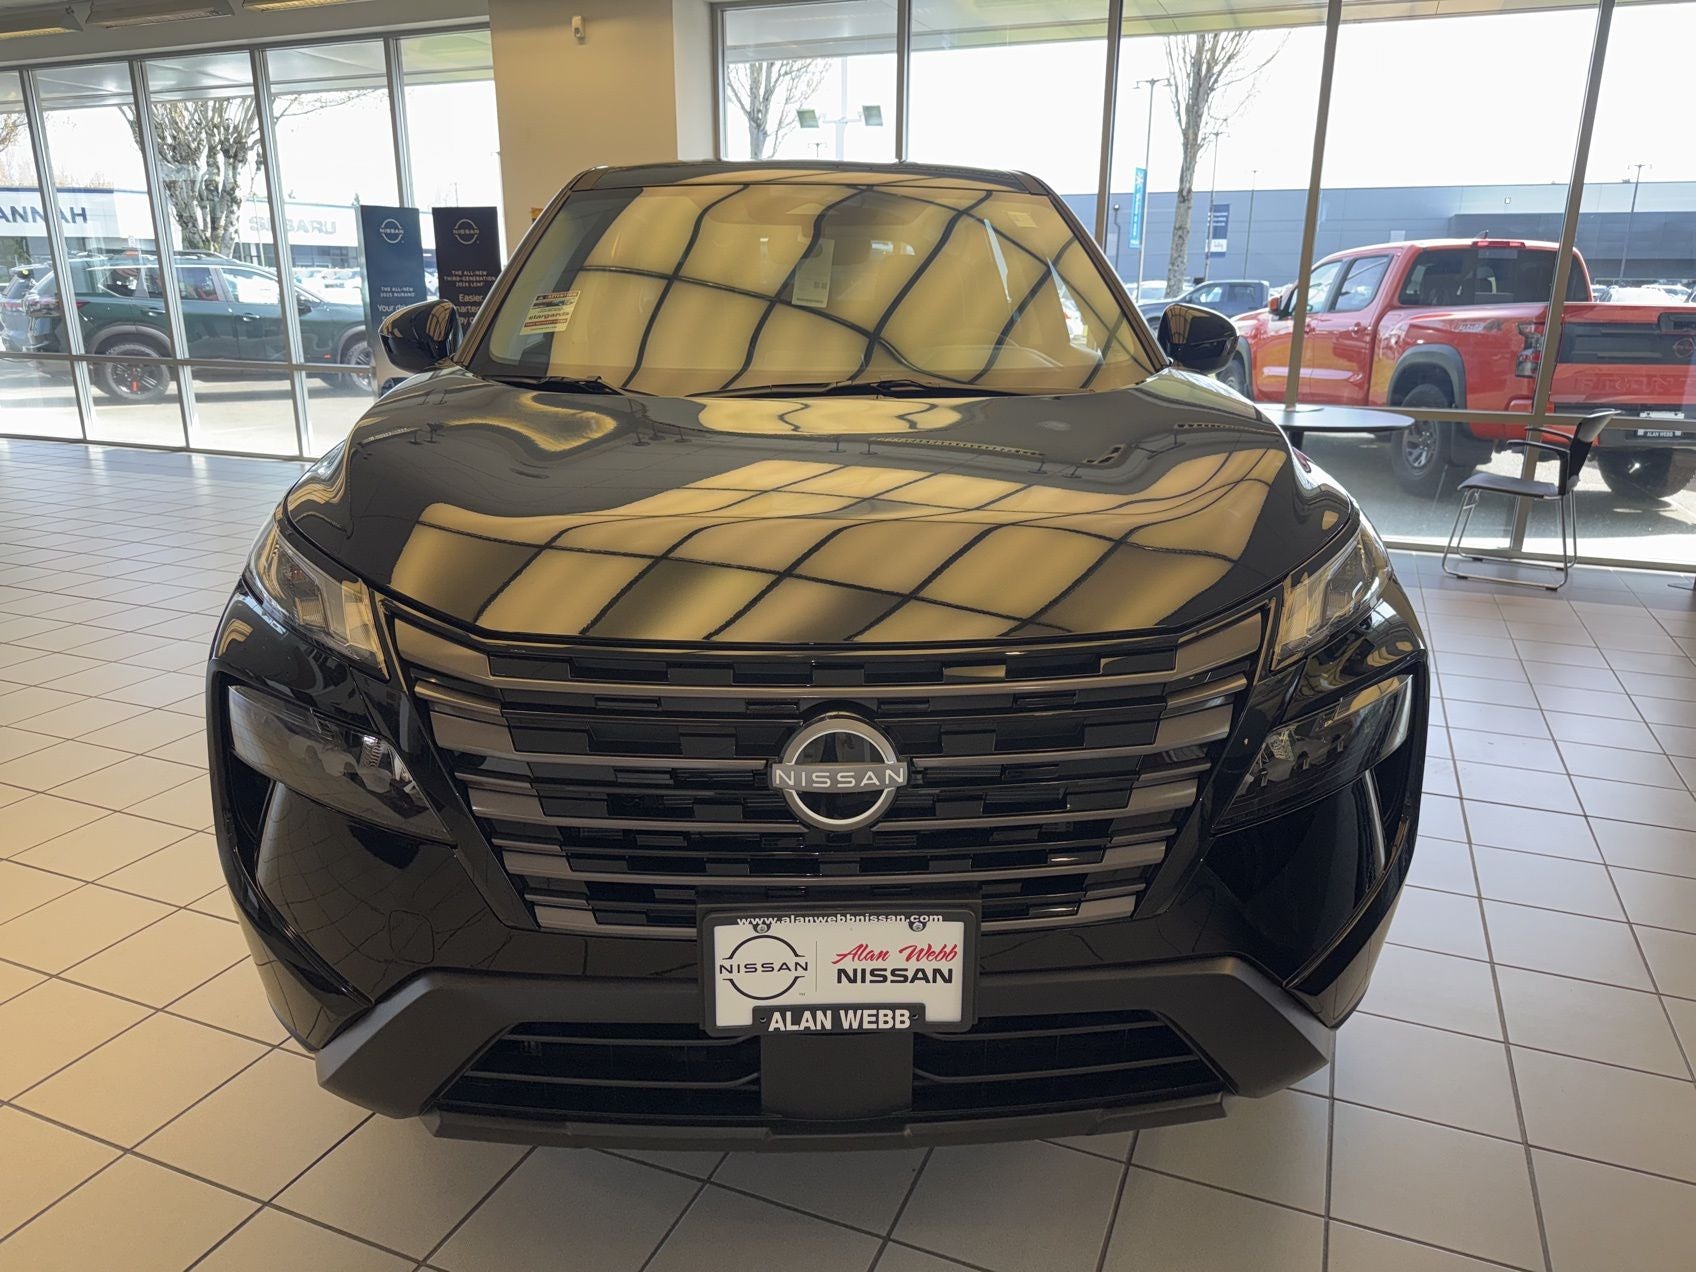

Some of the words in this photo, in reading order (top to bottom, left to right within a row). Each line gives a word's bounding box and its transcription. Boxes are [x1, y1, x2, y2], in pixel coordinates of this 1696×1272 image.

[775, 768, 904, 788] NISSAN
[737, 913, 943, 927] www.alanwebbnissan.com
[832, 943, 891, 965] Alan
[898, 943, 958, 963] Webb
[719, 961, 808, 975] NISSAN
[836, 968, 953, 984] NISSAN
[768, 1010, 832, 1032] ALAN
[839, 1009, 911, 1030] WEBB
